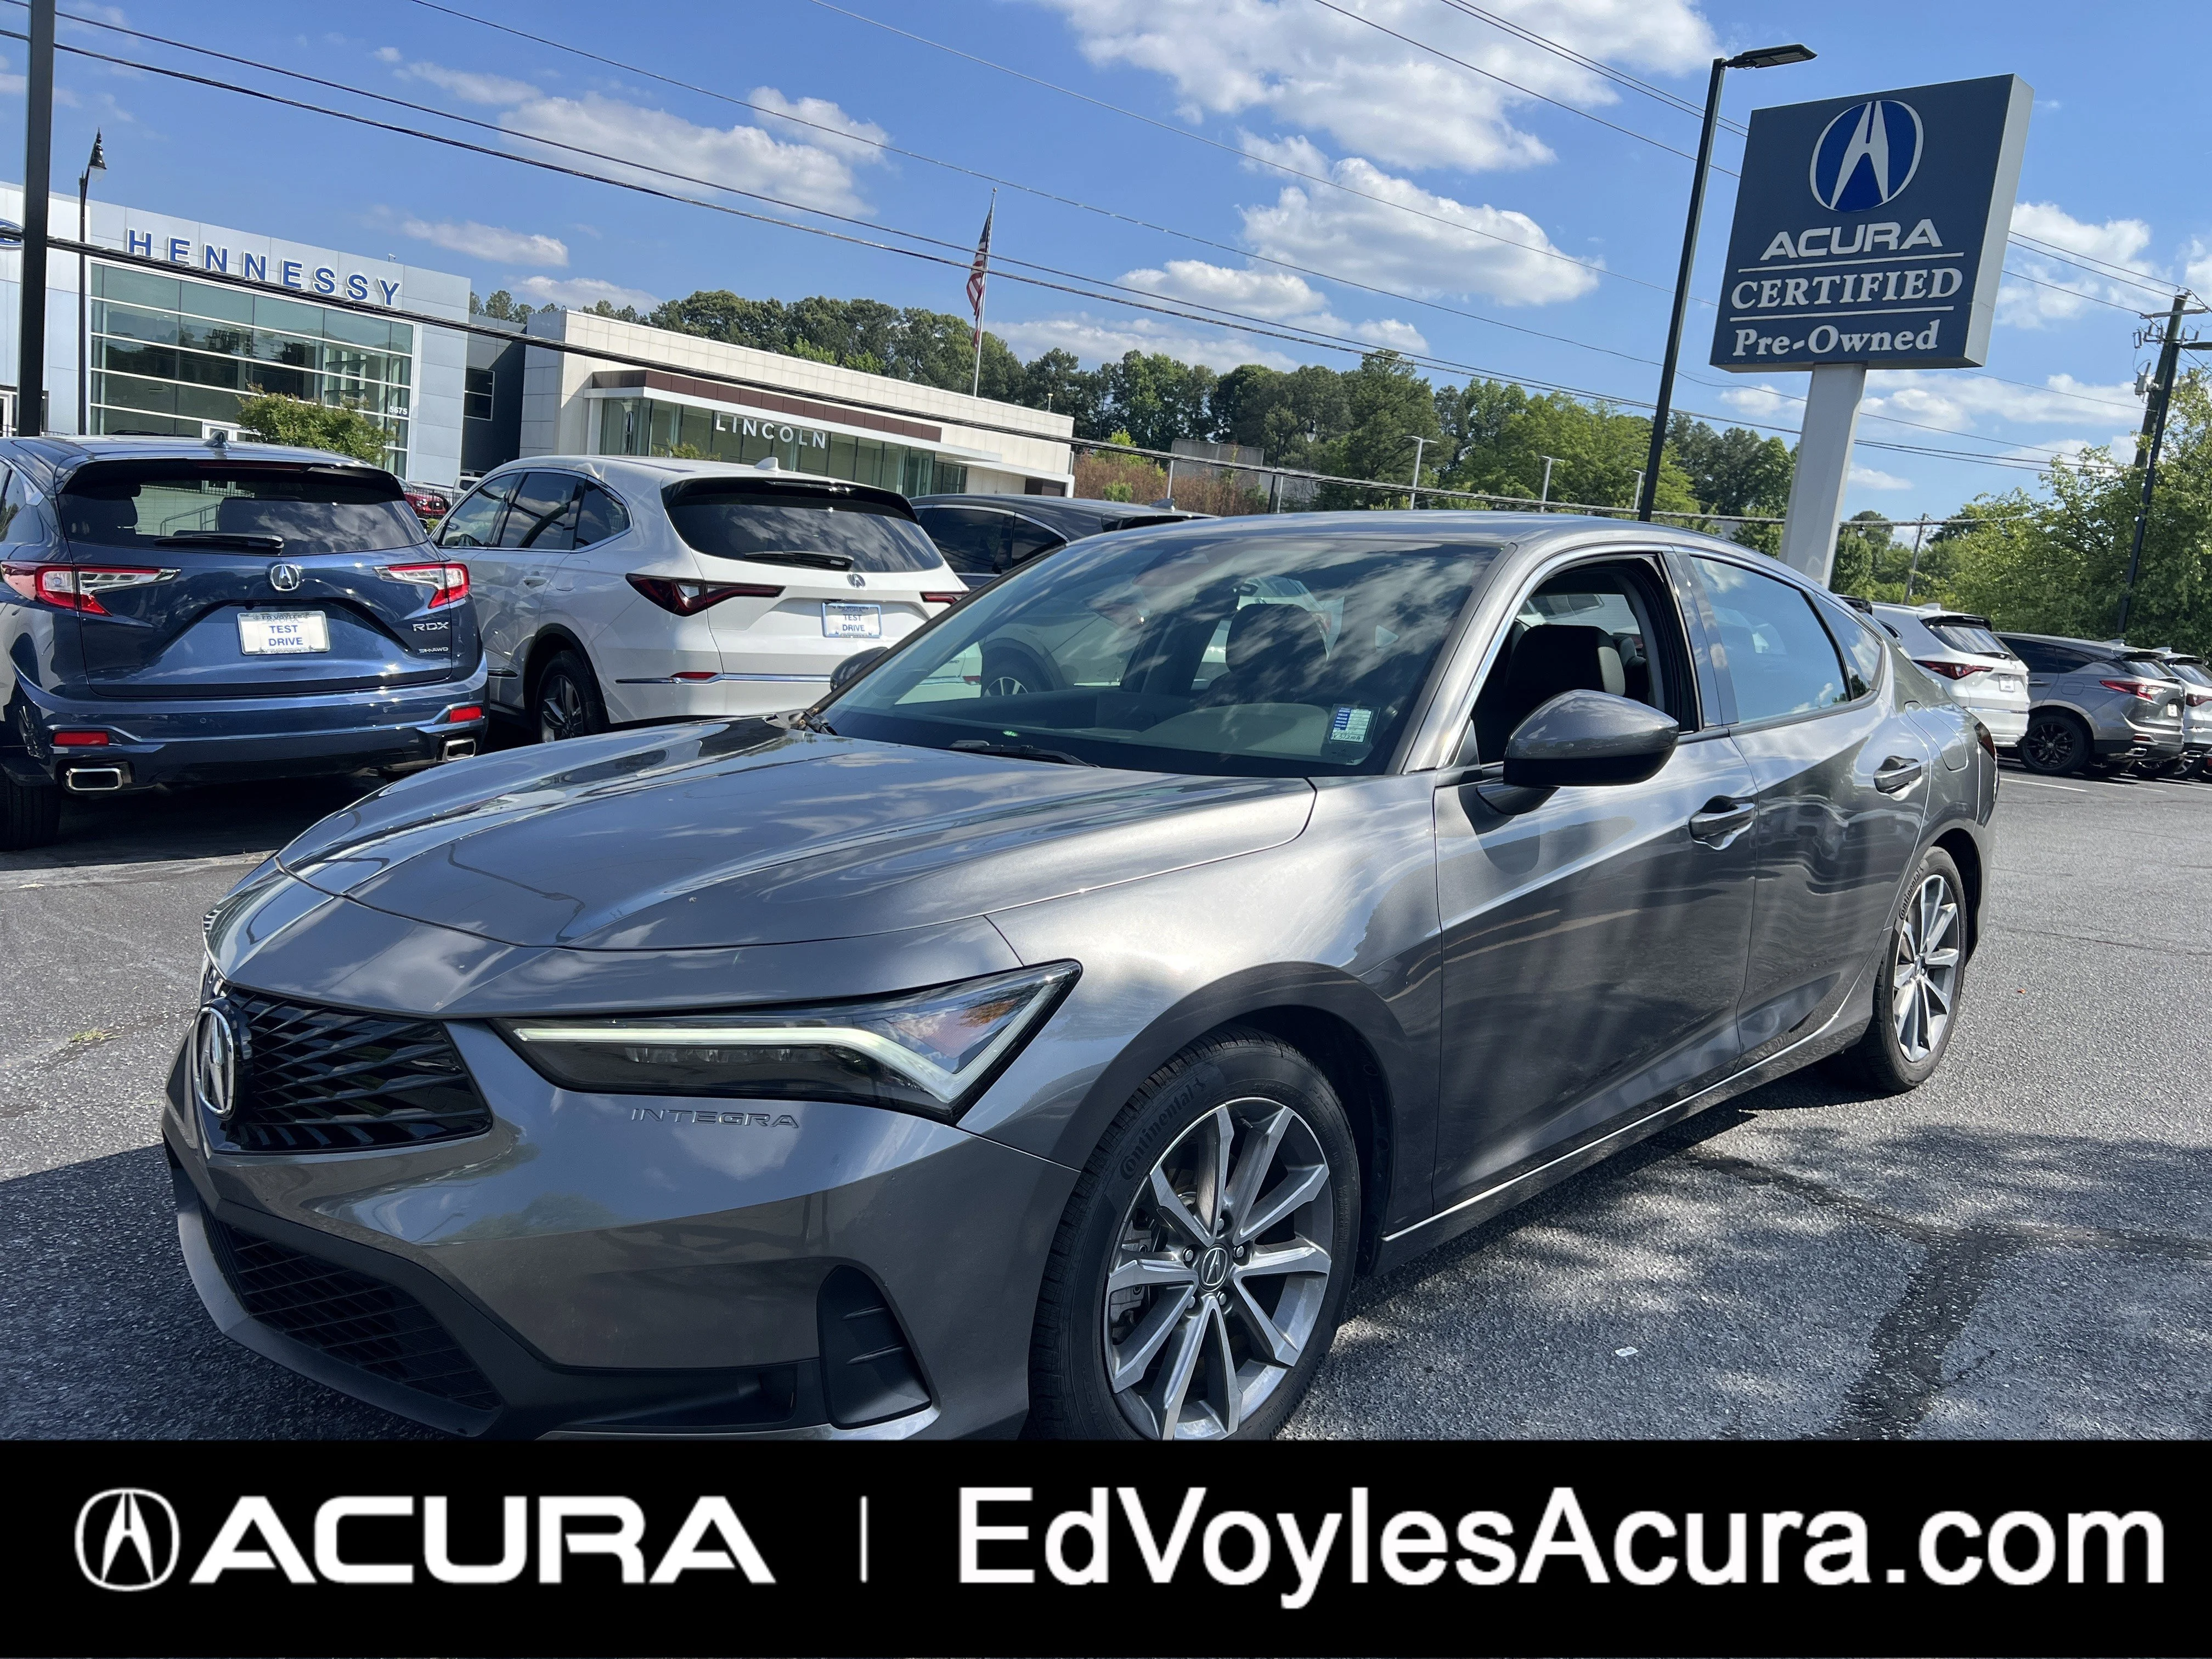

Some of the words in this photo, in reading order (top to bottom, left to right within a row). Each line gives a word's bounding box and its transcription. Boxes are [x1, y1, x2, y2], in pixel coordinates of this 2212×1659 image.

[1759, 218, 1943, 261] ACURA
[127, 228, 401, 306] HENNESSY
[1730, 267, 1963, 310] CERTIFIED
[1732, 319, 1941, 357] Pre-Owned
[389, 405, 408, 415] 5675
[715, 413, 826, 449] LINCOLN
[268, 625, 298, 634] TEST
[268, 637, 303, 646] DRIVE
[412, 622, 449, 631] RDX
[631, 1108, 799, 1129] INTEGRA
[1120, 1084, 1195, 1180] Continental
